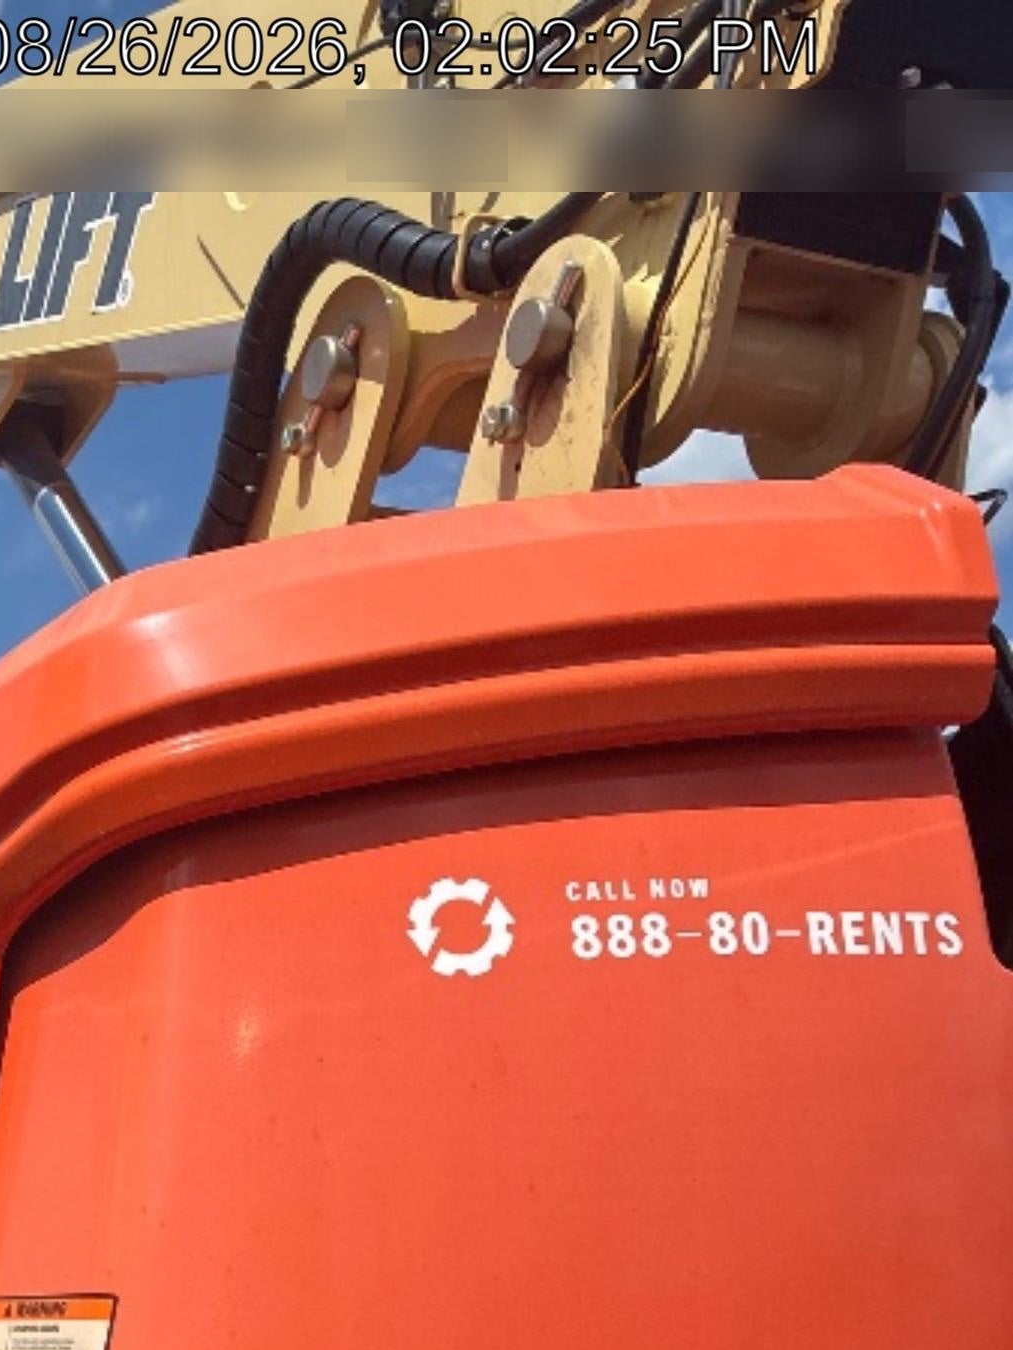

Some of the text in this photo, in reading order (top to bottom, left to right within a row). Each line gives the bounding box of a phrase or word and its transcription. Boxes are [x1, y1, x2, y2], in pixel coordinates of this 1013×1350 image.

[565, 877, 710, 901] CALL NOW
[571, 911, 964, 959] 888-80-RENTS
